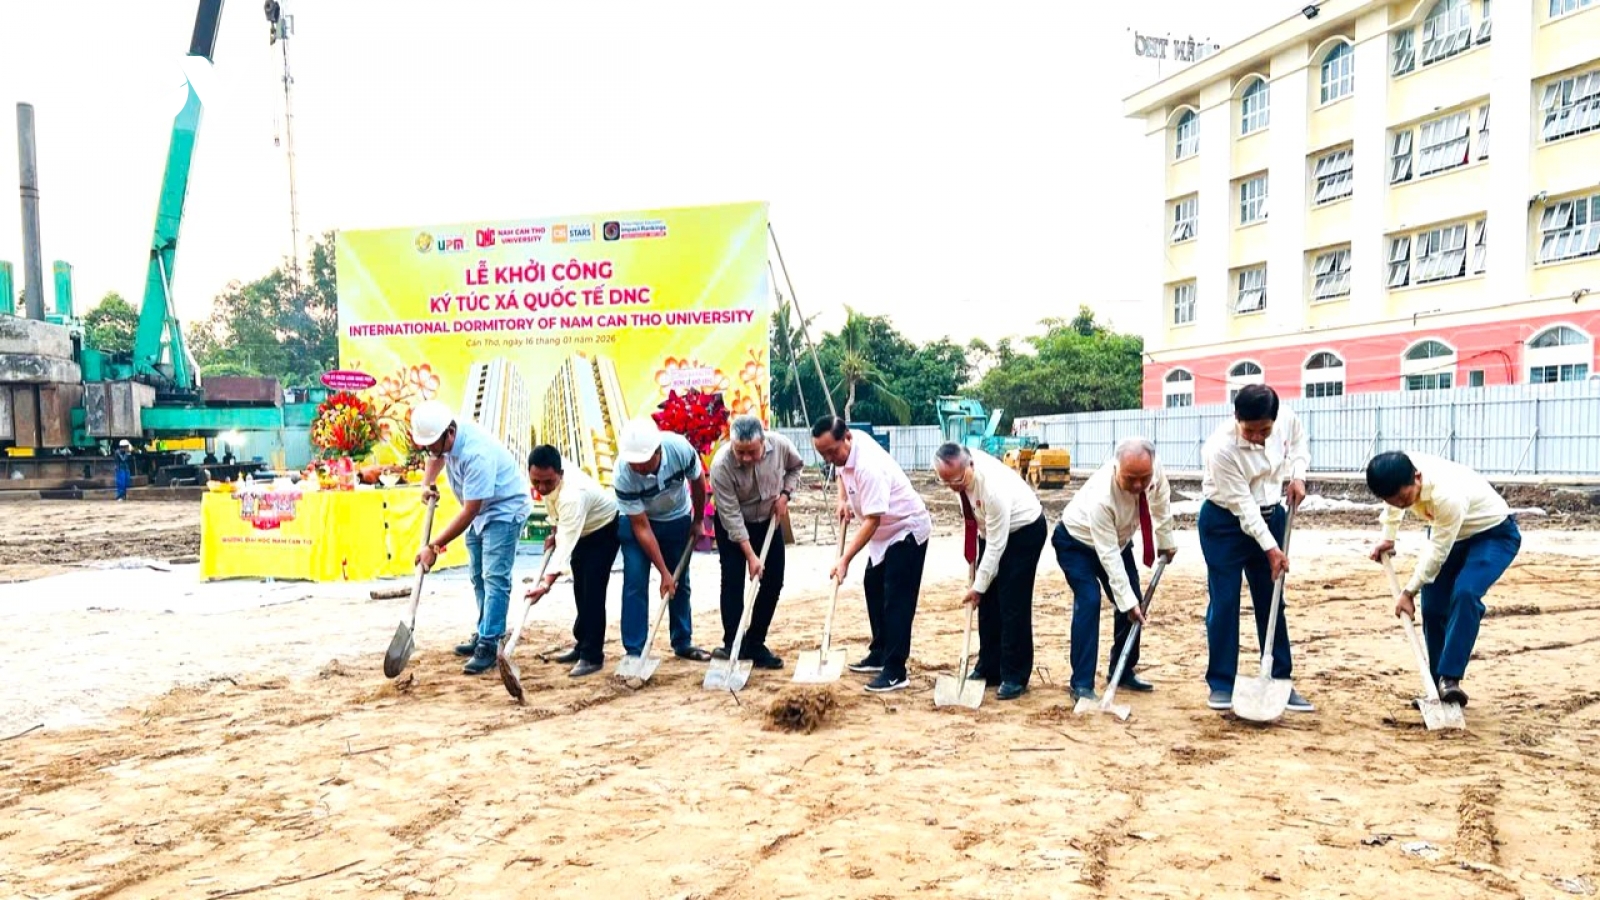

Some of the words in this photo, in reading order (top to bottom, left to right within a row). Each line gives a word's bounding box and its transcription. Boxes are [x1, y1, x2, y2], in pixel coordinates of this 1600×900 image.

[501, 235, 542, 244] UNIVERSITY
[569, 228, 591, 237] STARS
[465, 260, 489, 286] LỄ
[494, 260, 545, 285] KHỞI
[551, 258, 613, 282] CÔNG
[430, 292, 451, 314] KÝ
[455, 291, 490, 312] TÚC
[494, 289, 519, 310] XÁ
[523, 285, 577, 312] QUỐC
[581, 284, 605, 306] TẾ
[609, 287, 650, 305] DNC
[349, 321, 450, 337] INTERNATIONAL
[453, 317, 535, 333] DORMITORY
[538, 316, 558, 330] OF
[560, 315, 593, 329] NAM
[597, 314, 627, 327] CAN
[631, 313, 662, 326] THO
[666, 310, 754, 326] UNIVERSITY
[526, 337, 533, 345] 16
[595, 334, 616, 344] 2026
